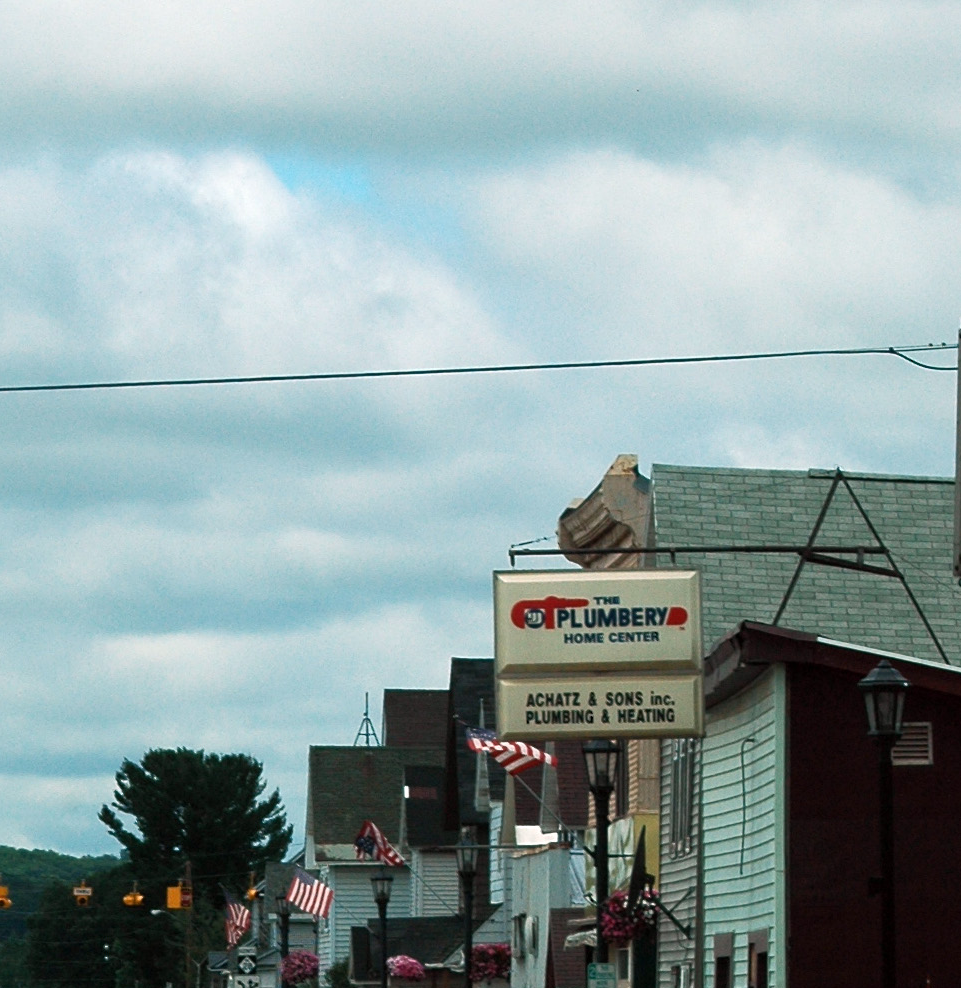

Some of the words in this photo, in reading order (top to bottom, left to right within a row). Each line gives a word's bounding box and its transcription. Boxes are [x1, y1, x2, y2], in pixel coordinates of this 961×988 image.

[593, 596, 620, 605] THE
[556, 607, 668, 628] PLUMBERY
[564, 632, 604, 644] HOME
[608, 631, 660, 643] CENTER
[526, 692, 581, 707] ACHATZ
[588, 692, 597, 706] &
[605, 691, 643, 706] SONS
[650, 690, 675, 706] inc.
[526, 709, 594, 725] PLUMBING
[601, 709, 610, 723] &
[617, 708, 675, 723] HEATING
